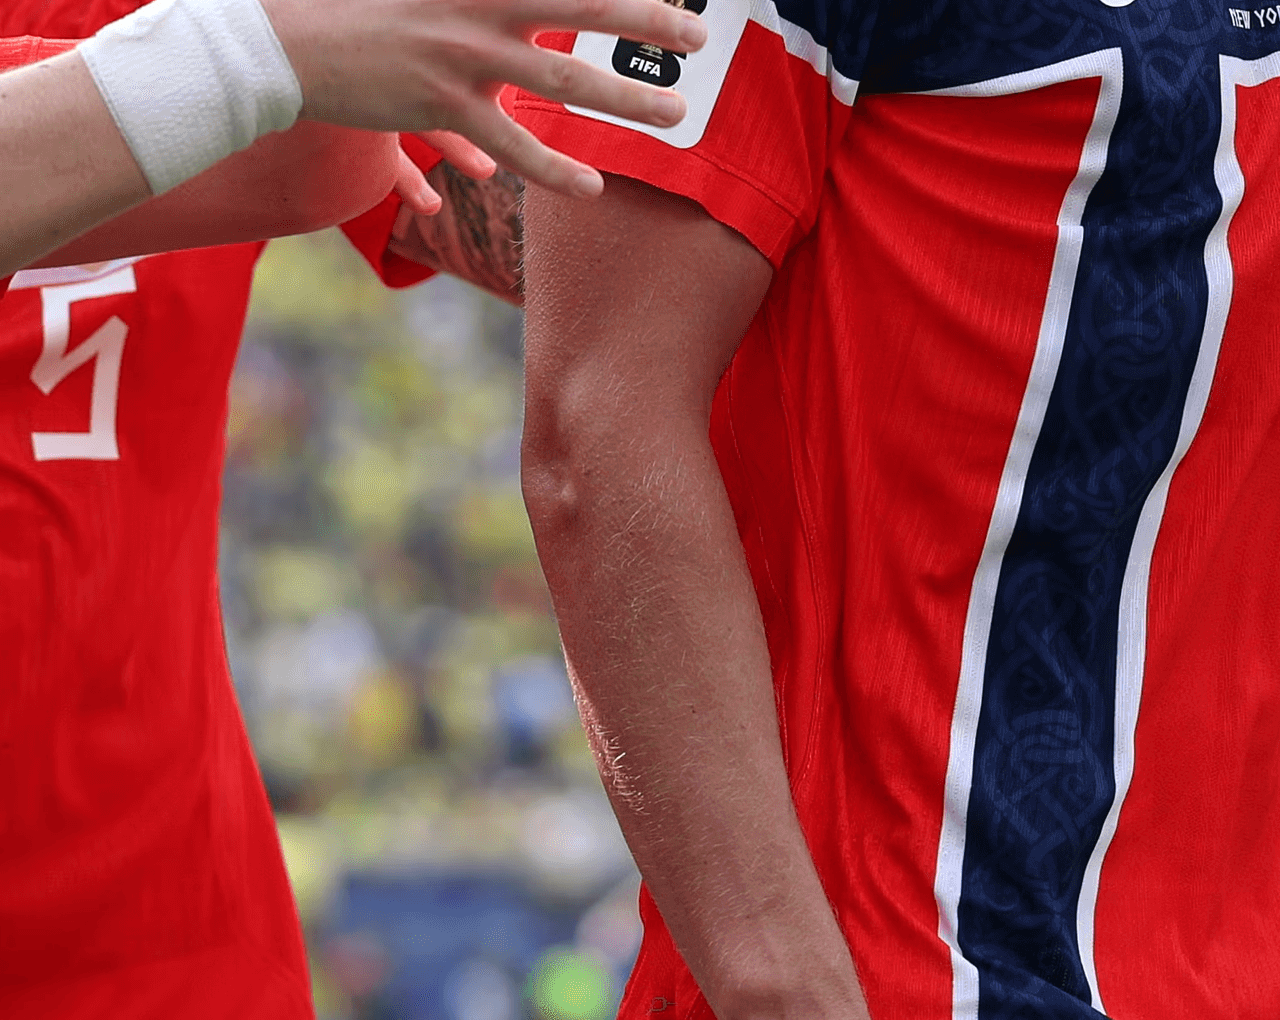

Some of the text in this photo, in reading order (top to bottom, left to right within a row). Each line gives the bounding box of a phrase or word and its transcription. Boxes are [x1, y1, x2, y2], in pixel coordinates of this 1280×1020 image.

[1228, 8, 1251, 30] NEW
[629, 56, 661, 77] FIFA
[29, 264, 137, 461] 5
